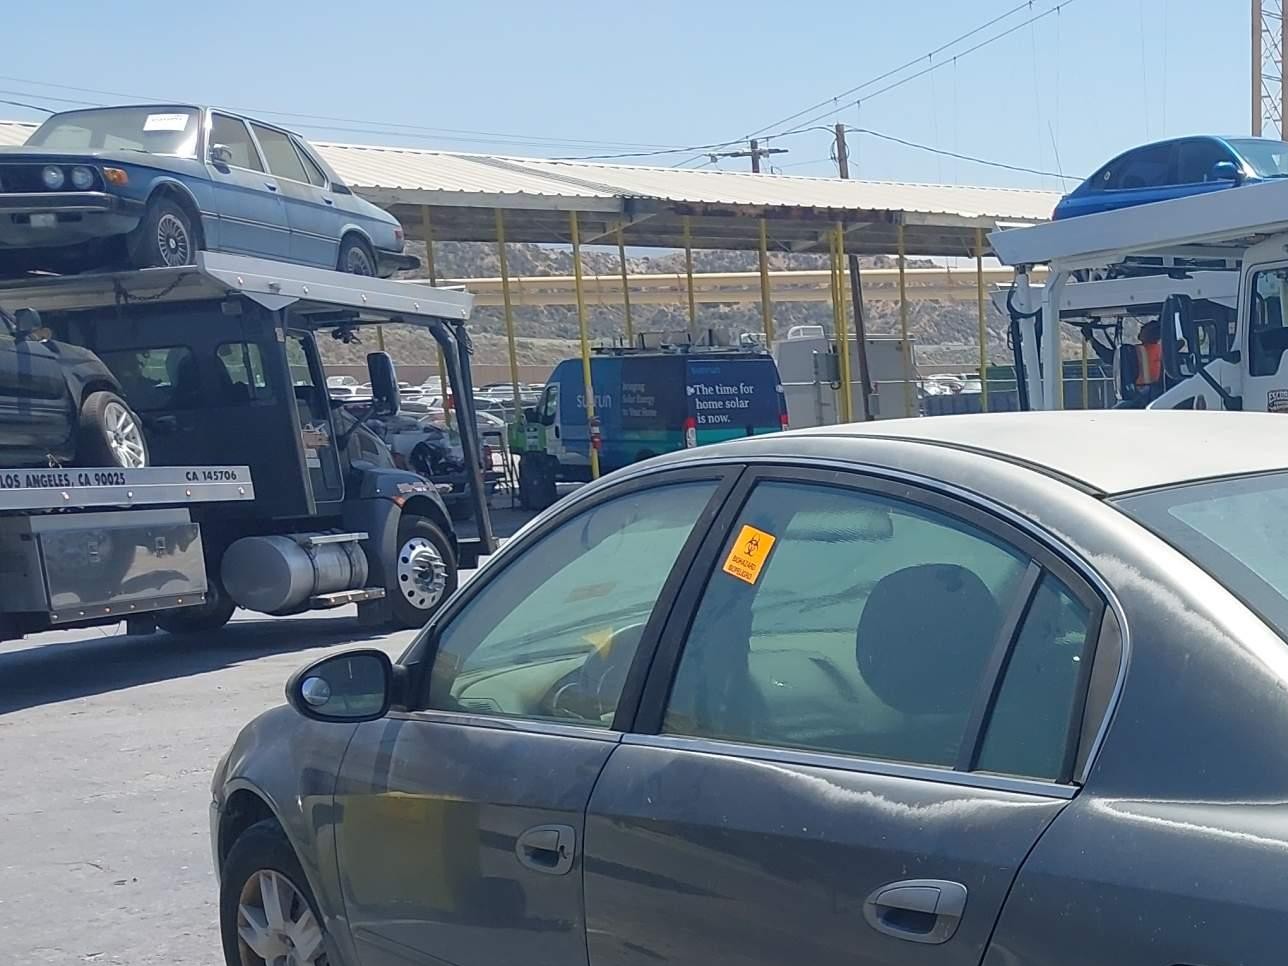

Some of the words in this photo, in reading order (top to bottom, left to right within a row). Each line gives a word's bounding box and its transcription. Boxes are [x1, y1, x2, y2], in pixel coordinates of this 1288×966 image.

[694, 383, 714, 395] The
[715, 383, 738, 394] time
[739, 382, 755, 394] for
[576, 394, 612, 409] surun
[695, 397, 723, 410] home
[725, 398, 750, 409] solar
[697, 412, 706, 424] is
[708, 414, 731, 424] now.
[0, 473, 20, 489] LOS
[78, 472, 91, 486] CA
[94, 472, 126, 485] 90025
[185, 470, 199, 482] CA
[202, 470, 238, 481] 145706
